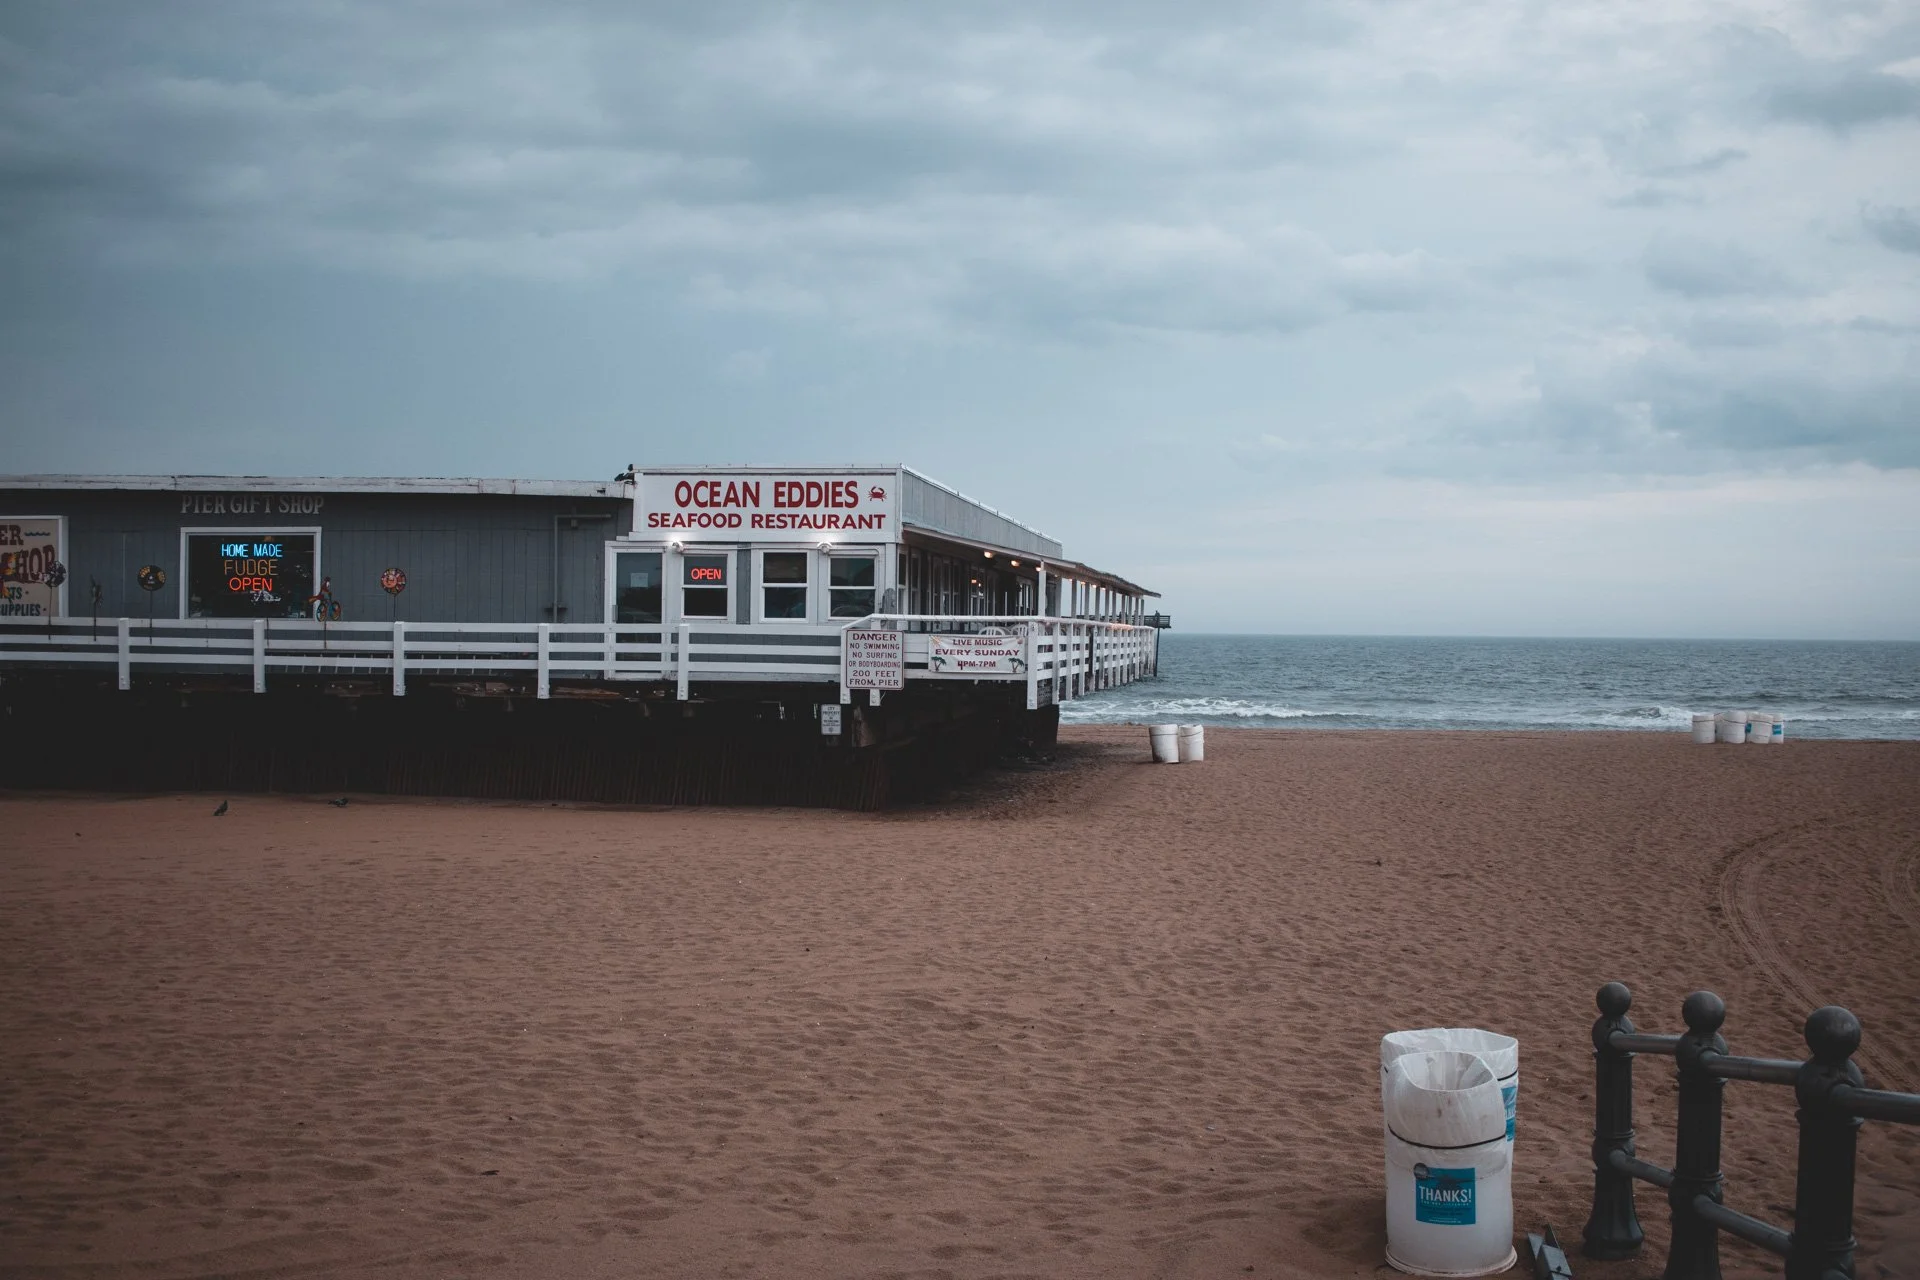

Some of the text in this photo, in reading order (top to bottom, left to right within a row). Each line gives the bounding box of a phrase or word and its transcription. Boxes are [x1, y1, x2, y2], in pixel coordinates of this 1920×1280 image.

[674, 480, 859, 508] OCEAN EDDIES
[180, 494, 324, 514] PIER GIFT SHOP
[647, 512, 886, 529] SEAFOOD RESTAURANT
[221, 543, 283, 557] HOME MADE
[0, 544, 56, 582] HOP
[224, 559, 279, 576] FUDGE
[691, 568, 722, 580] OPEN
[229, 577, 273, 592] OPEN
[0, 603, 41, 616] UPPLIES
[852, 633, 897, 641] DANGER
[953, 638, 972, 646] LIVE
[850, 642, 860, 650] NO
[935, 648, 971, 656] EVERY
[866, 651, 897, 659] SURFING
[858, 660, 901, 668] BODYBOARDING
[957, 660, 996, 670] 4PM-7PM
[852, 669, 896, 678] 200 FEET
[1418, 1185, 1472, 1203] THANKS!
